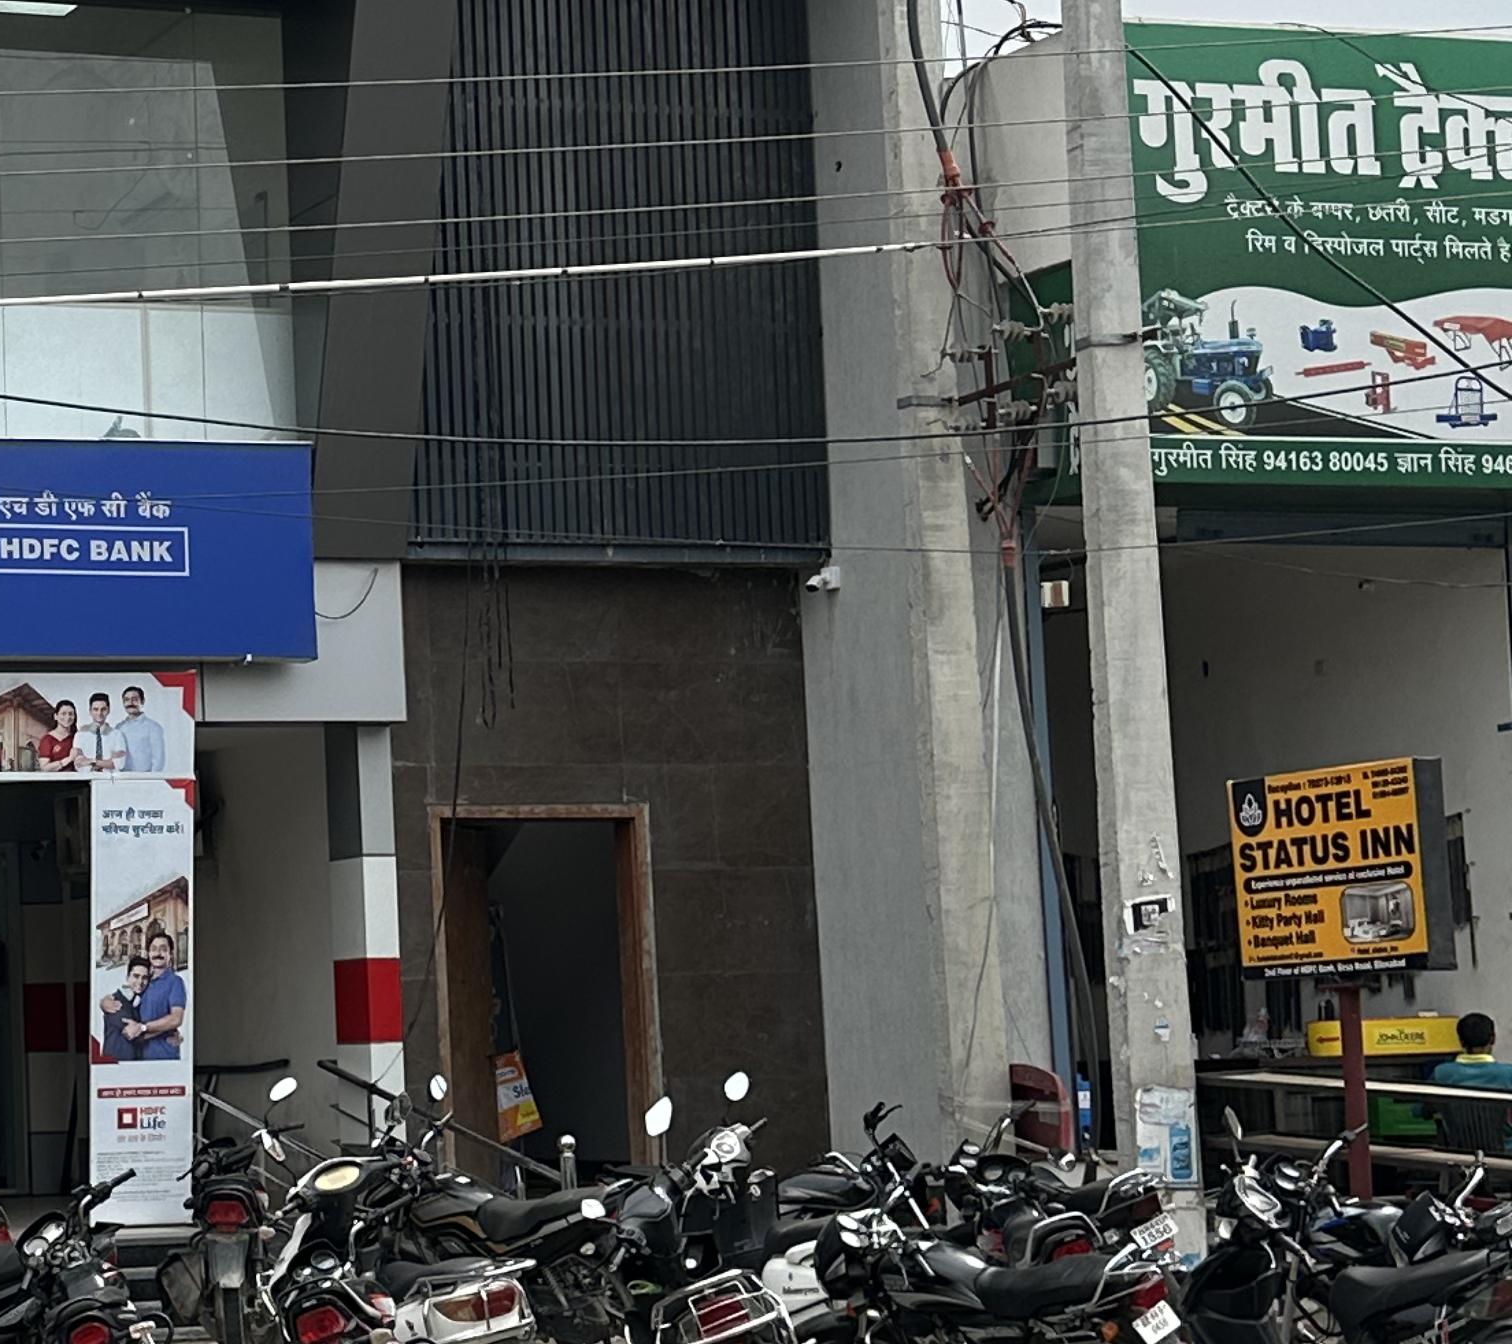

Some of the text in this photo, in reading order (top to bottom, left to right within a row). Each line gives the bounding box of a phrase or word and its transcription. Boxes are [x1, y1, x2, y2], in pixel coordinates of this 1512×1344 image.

[1133, 58, 1381, 203] गुरमीत
[1285, 194, 1304, 219] के
[1245, 228, 1276, 254] रिम
[1283, 235, 1296, 254] व
[1444, 234, 1493, 260] मिलते
[1151, 442, 1212, 475] गुरमीत
[1219, 443, 1256, 472] सिंह
[1263, 451, 1323, 471] 94163
[1329, 451, 1388, 472] 80045
[1394, 452, 1432, 473] ज्ञान
[1439, 446, 1476, 475] सिंह
[34, 489, 59, 516] डी
[63, 498, 96, 521] एफ
[101, 491, 128, 518] सी
[136, 490, 172, 519] बैंक
[0, 537, 173, 563] HDFC BANK
[1272, 789, 1372, 829] HOTEL
[1239, 823, 1416, 873] STATUS INN
[1250, 892, 1318, 911] Luxury Rooms
[1252, 909, 1325, 931] Kitty Party Hall
[1253, 930, 1316, 950] Banquet Hall
[139, 1106, 167, 1115] HDFC
[139, 1116, 167, 1130] Life
